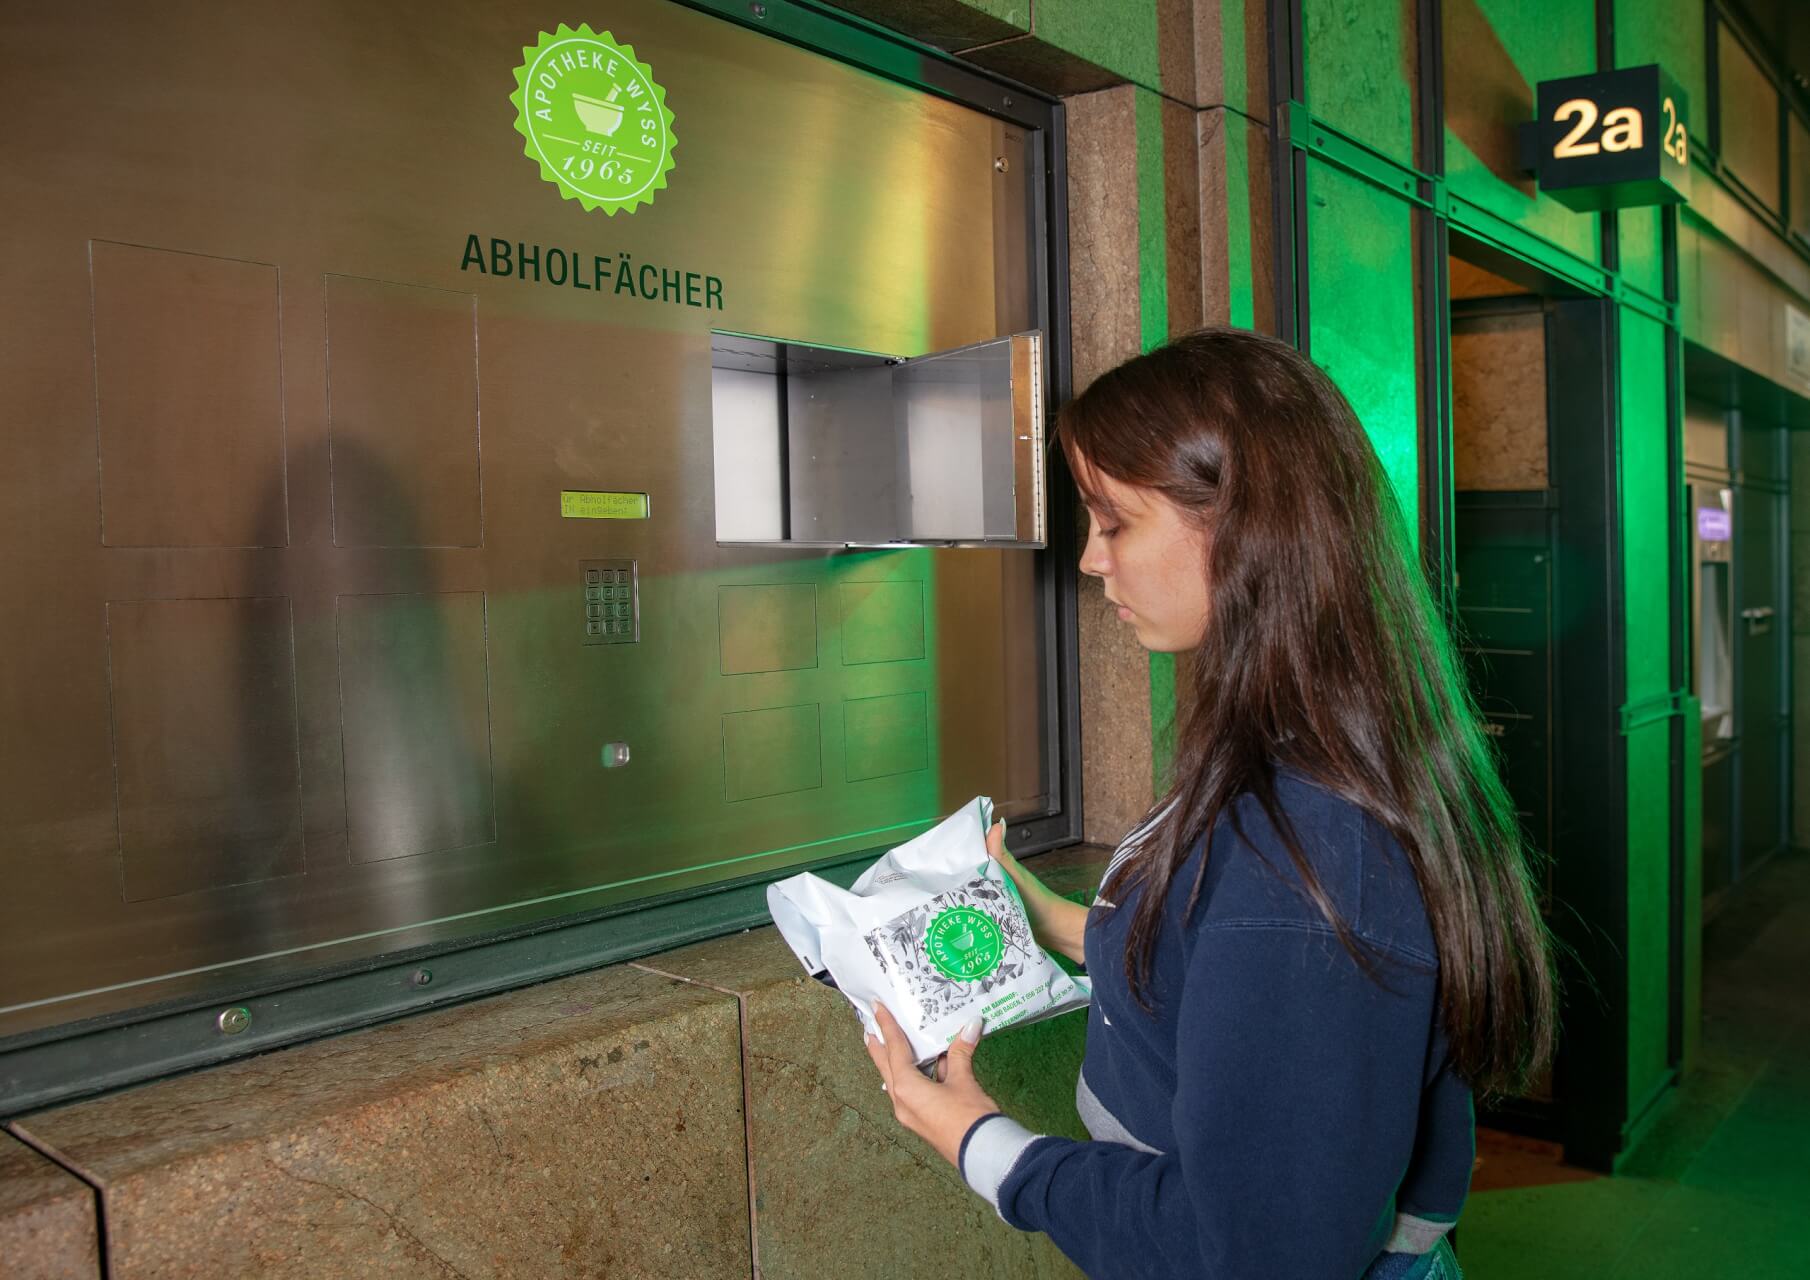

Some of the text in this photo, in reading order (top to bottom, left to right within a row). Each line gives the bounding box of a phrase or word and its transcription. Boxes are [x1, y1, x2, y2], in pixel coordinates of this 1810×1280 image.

[535, 49, 657, 148] APOTHEKE WYSS
[581, 139, 617, 157] SEIT
[1553, 98, 1644, 160] 2a
[1662, 97, 1688, 167] 2a
[561, 155, 635, 185] 1965
[460, 233, 724, 311] ABHOLFÄCHER
[934, 915, 993, 962] APOTHEKE WYSS
[963, 948, 978, 960] SEIT
[960, 951, 991, 974] 1965
